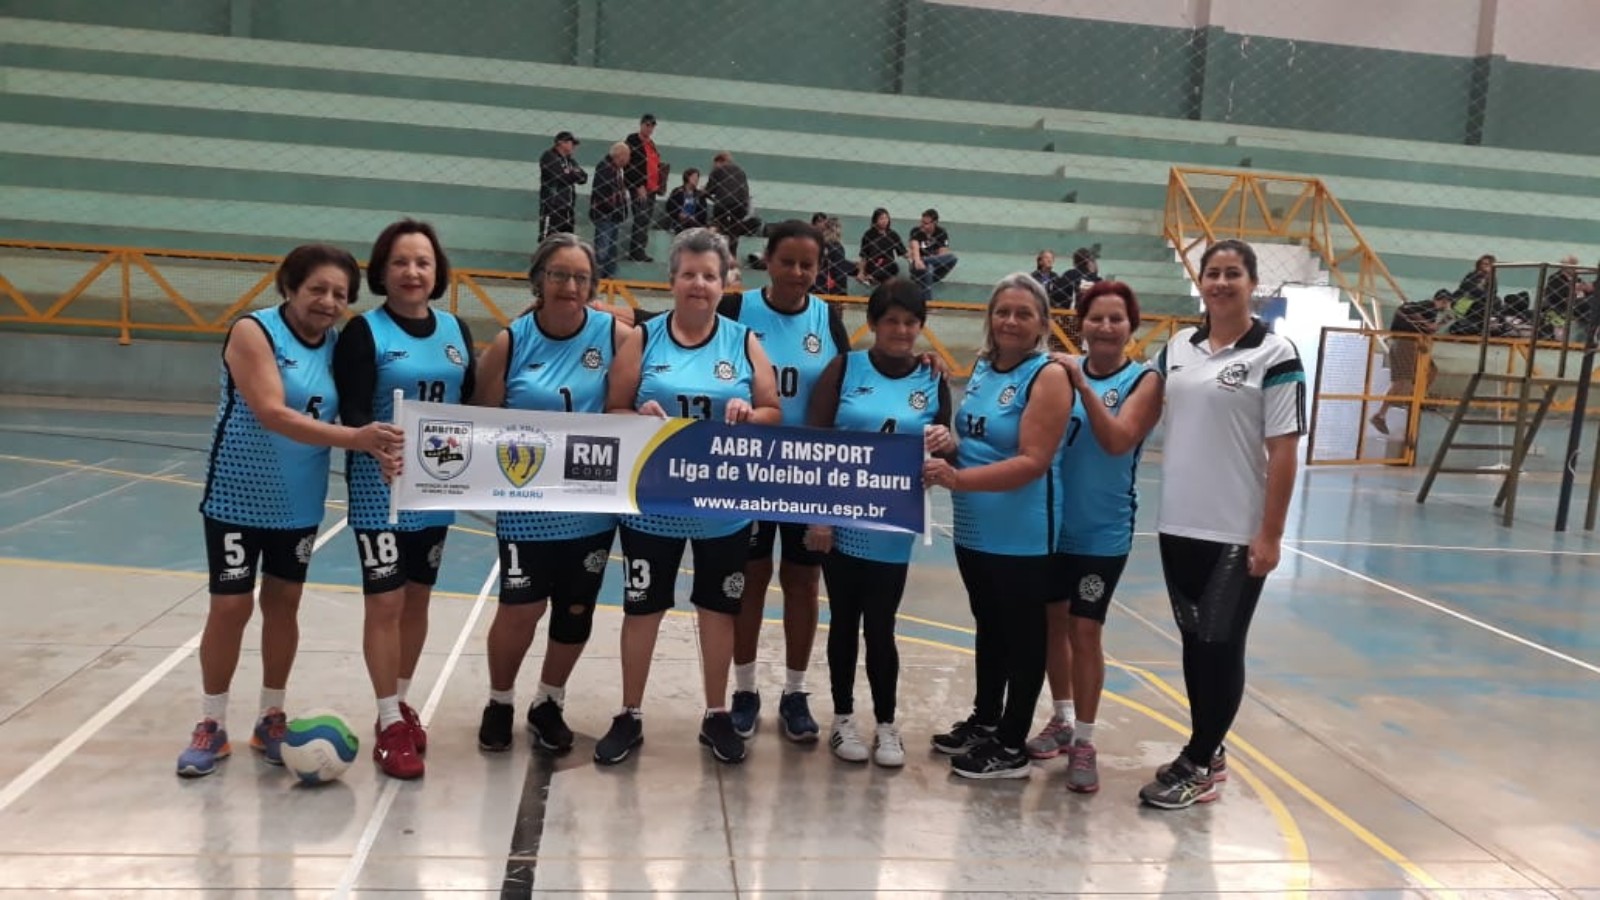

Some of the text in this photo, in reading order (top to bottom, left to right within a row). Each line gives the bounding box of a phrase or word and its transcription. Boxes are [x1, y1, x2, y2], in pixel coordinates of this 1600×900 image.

[558, 387, 573, 412] 1
[676, 394, 713, 419] 13
[424, 425, 469, 435] ARBITRO
[966, 413, 988, 439] 14
[572, 442, 614, 467] RM
[710, 436, 874, 465] AABR / RMSPORT
[668, 458, 911, 491] Liga de Voleibol de Bauru
[509, 489, 543, 499] BAURU
[693, 497, 887, 519] www.aabrbauru.esp.br
[224, 532, 246, 566] 5
[359, 532, 399, 567] 18
[508, 543, 523, 576] 1
